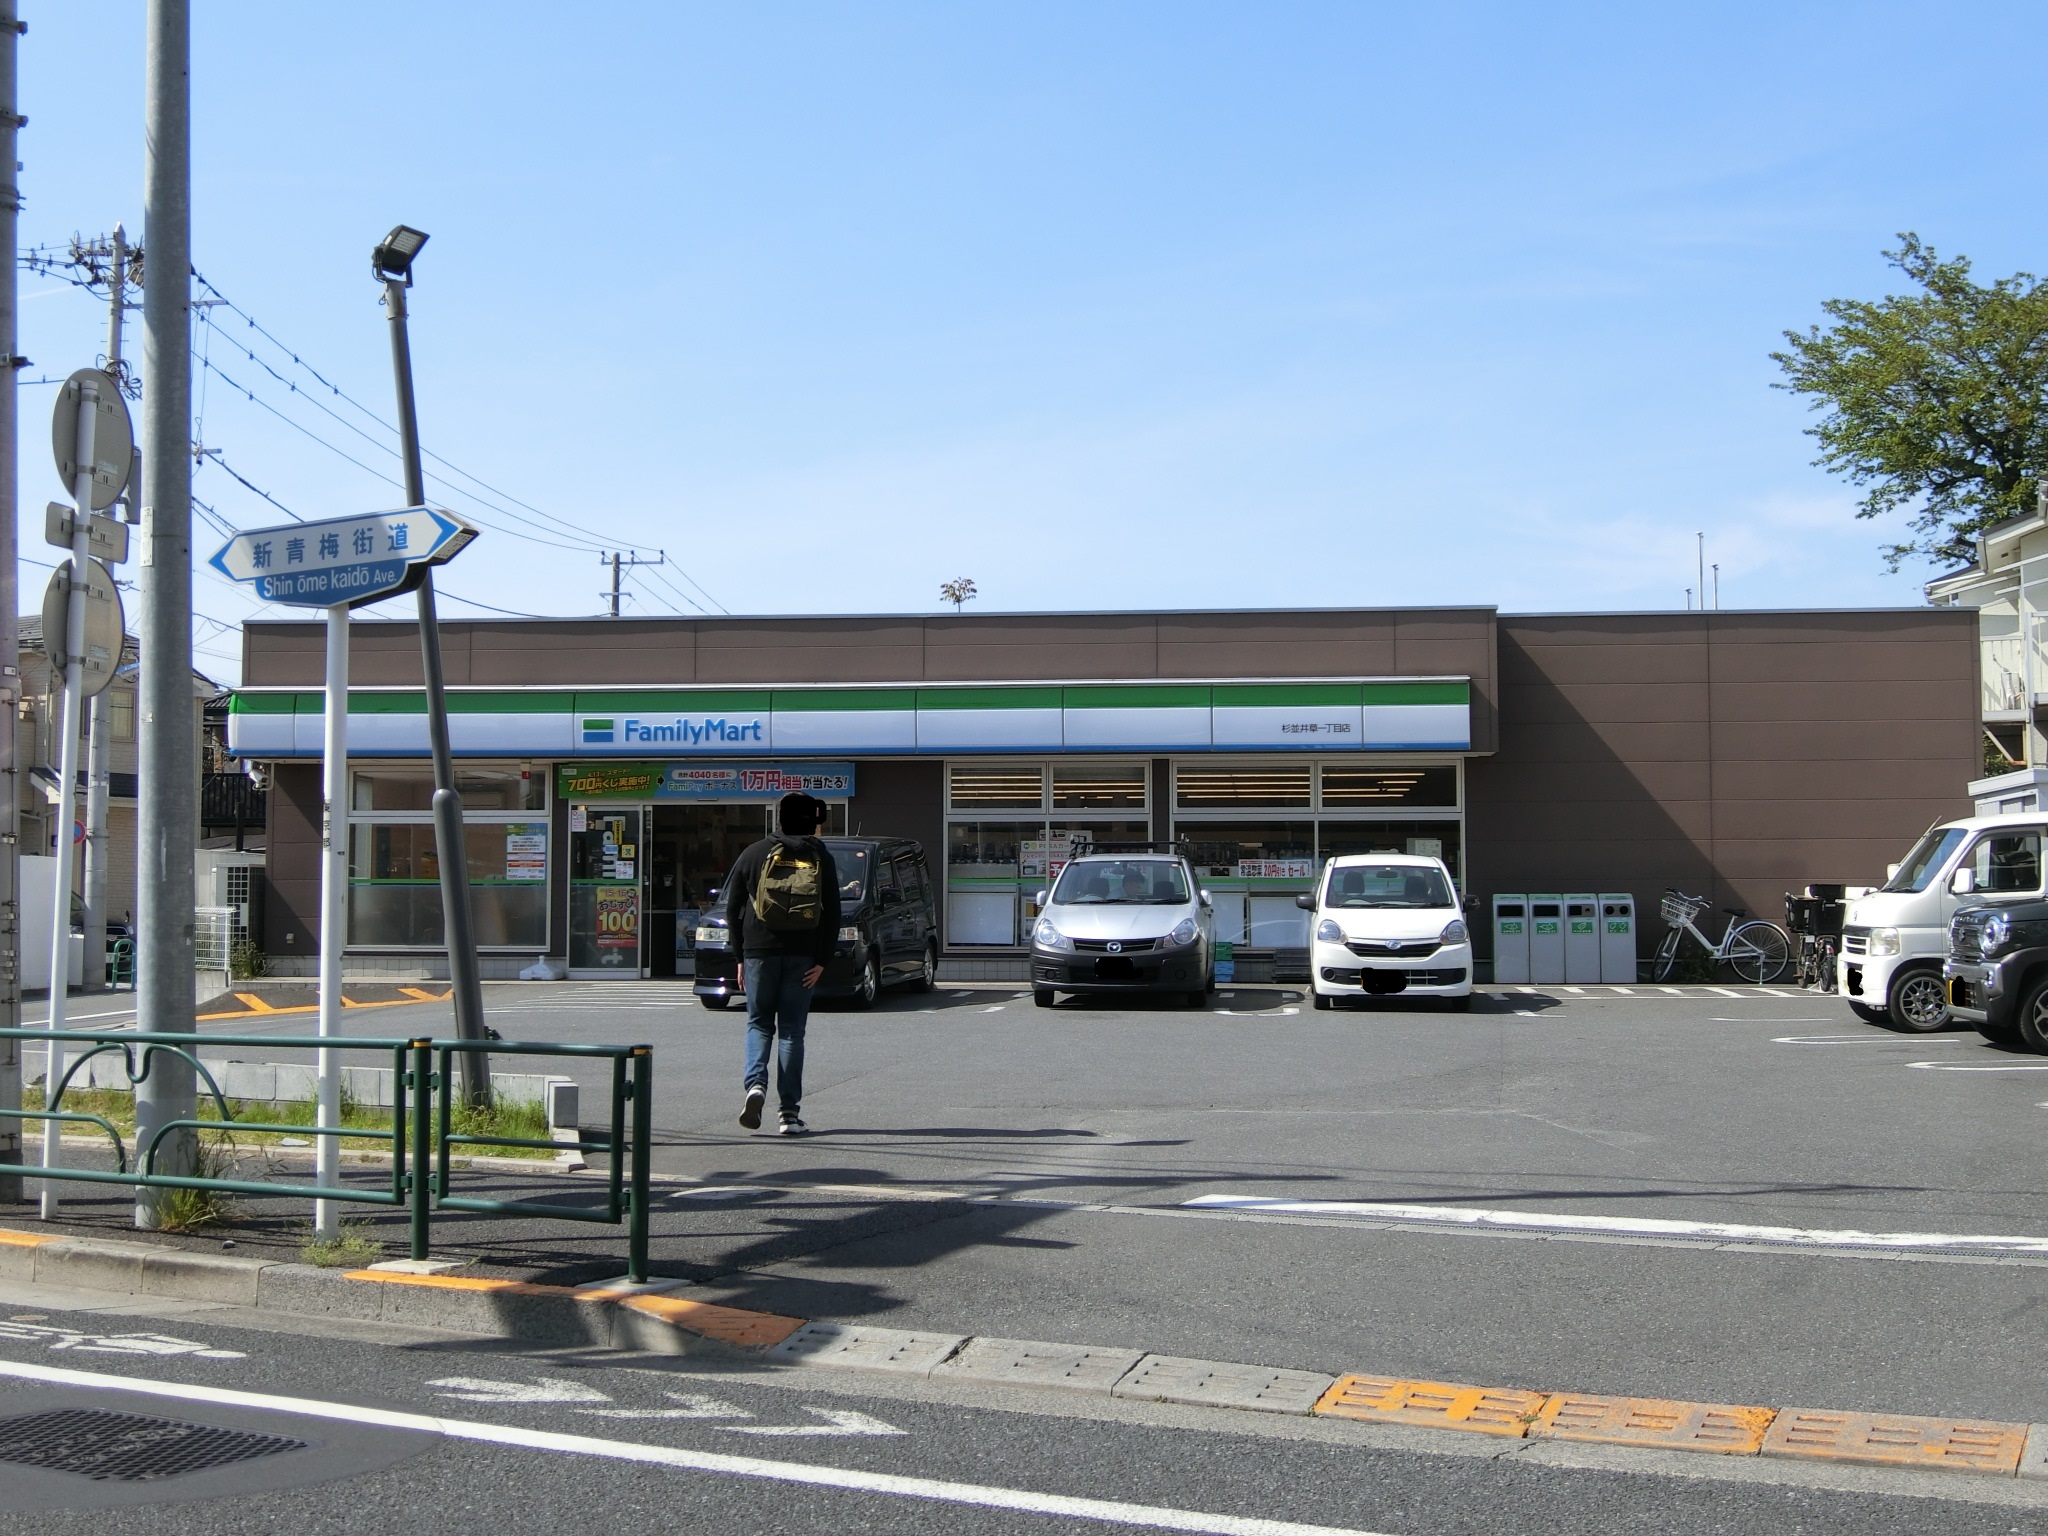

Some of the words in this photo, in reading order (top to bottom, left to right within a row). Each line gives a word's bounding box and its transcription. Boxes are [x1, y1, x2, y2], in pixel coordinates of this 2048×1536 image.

[252, 523, 409, 569] 新青梅街道
[263, 574, 293, 598] Shin
[297, 574, 327, 593] ōme
[330, 566, 369, 590] kaidō
[373, 570, 397, 584] Ave.
[624, 718, 762, 745] FamilyMart
[1281, 723, 1351, 733] 杉並井草一丁目店
[668, 781, 703, 791] FamiPay
[705, 781, 737, 790] ボーナス
[740, 769, 848, 791] 1万円相当が当たる!
